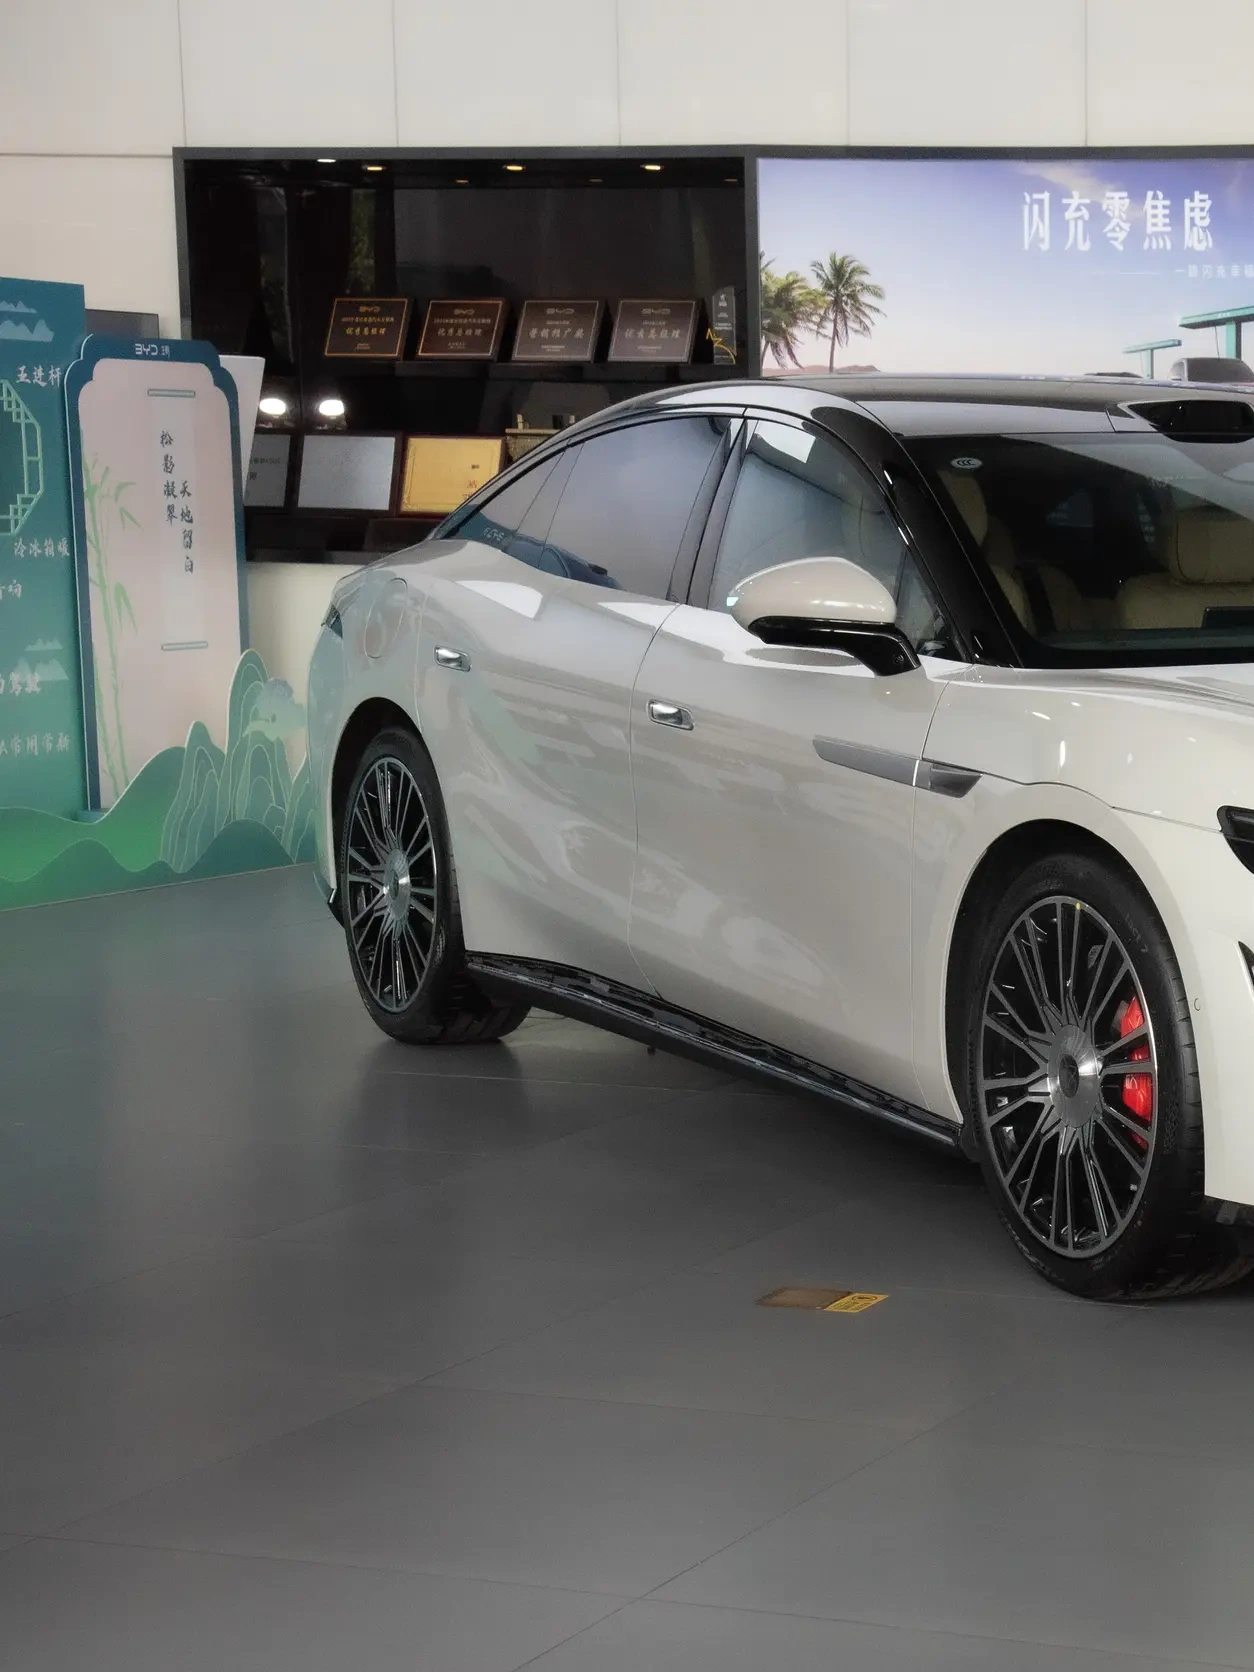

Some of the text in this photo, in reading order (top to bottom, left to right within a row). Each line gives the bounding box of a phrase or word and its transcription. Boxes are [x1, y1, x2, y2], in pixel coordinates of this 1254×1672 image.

[1022, 189, 1214, 252] 闪充零焦虑
[160, 430, 178, 528] 松影凝翠
